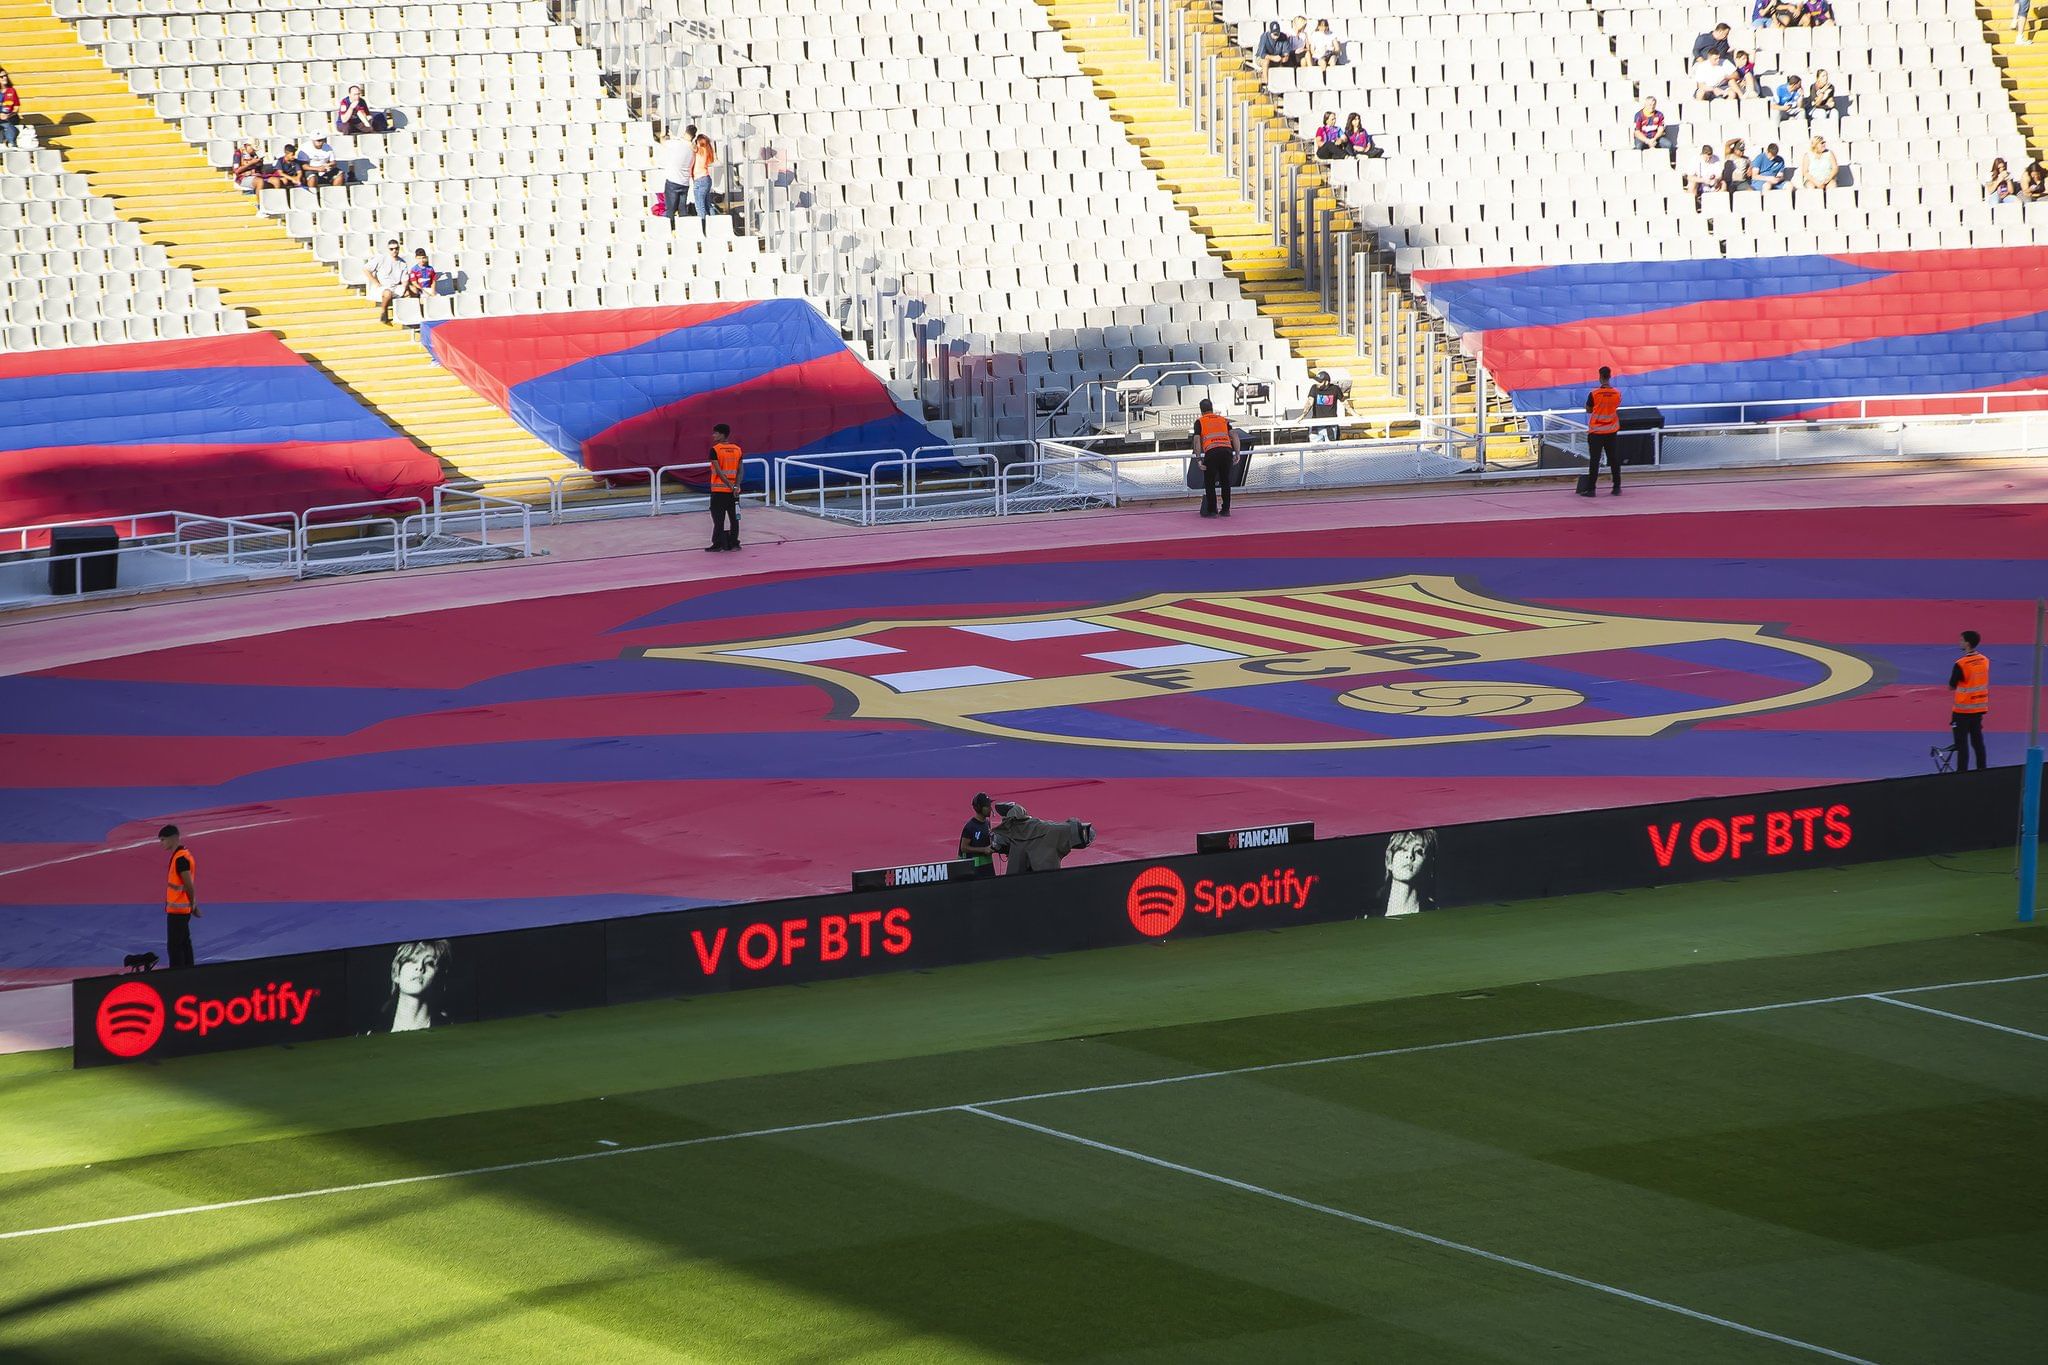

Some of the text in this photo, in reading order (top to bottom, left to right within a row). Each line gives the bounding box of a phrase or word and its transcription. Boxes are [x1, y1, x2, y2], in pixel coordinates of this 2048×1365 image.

[1228, 827, 1289, 849] #FANCAM
[1647, 804, 1852, 868] V OF BTS
[884, 863, 948, 886] #FANCAM
[1194, 868, 1313, 918] Spotify
[691, 907, 912, 975] V OF BTS
[174, 982, 313, 1036] Spotify
